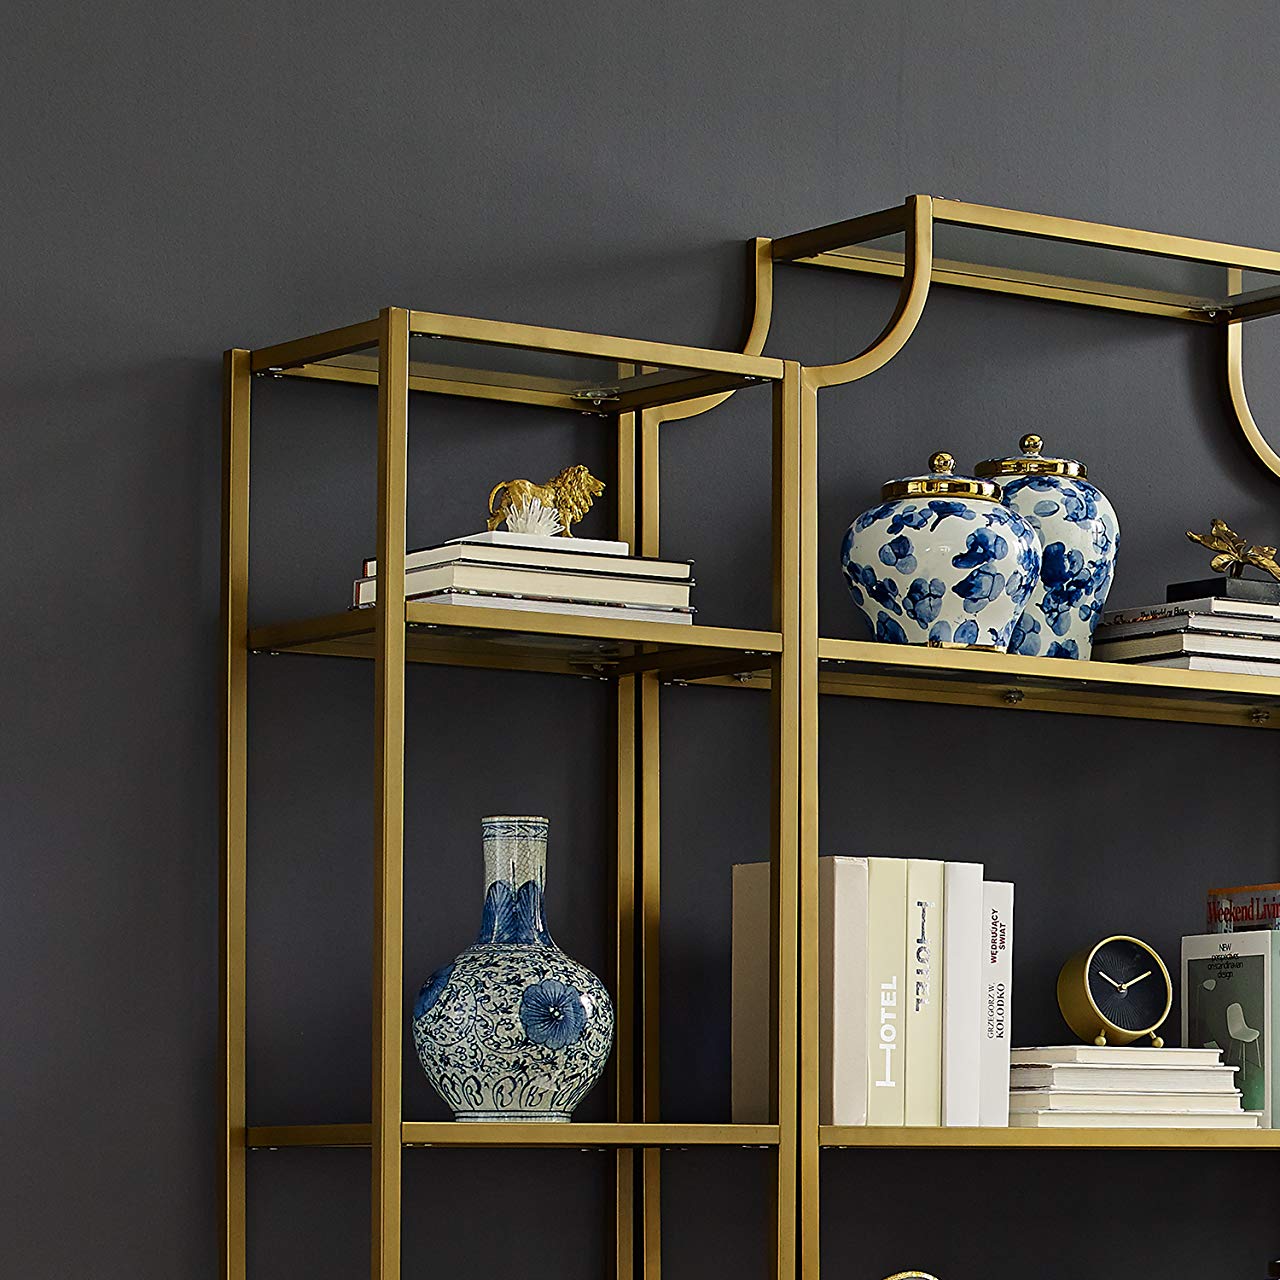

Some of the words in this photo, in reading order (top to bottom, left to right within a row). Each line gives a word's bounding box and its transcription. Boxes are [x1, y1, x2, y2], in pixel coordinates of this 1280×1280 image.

[1207, 898, 1254, 923] Weekend
[1218, 943, 1232, 952] NEW
[875, 975, 898, 1088] HOTEL
[987, 993, 996, 1039] GRZEGORZ
